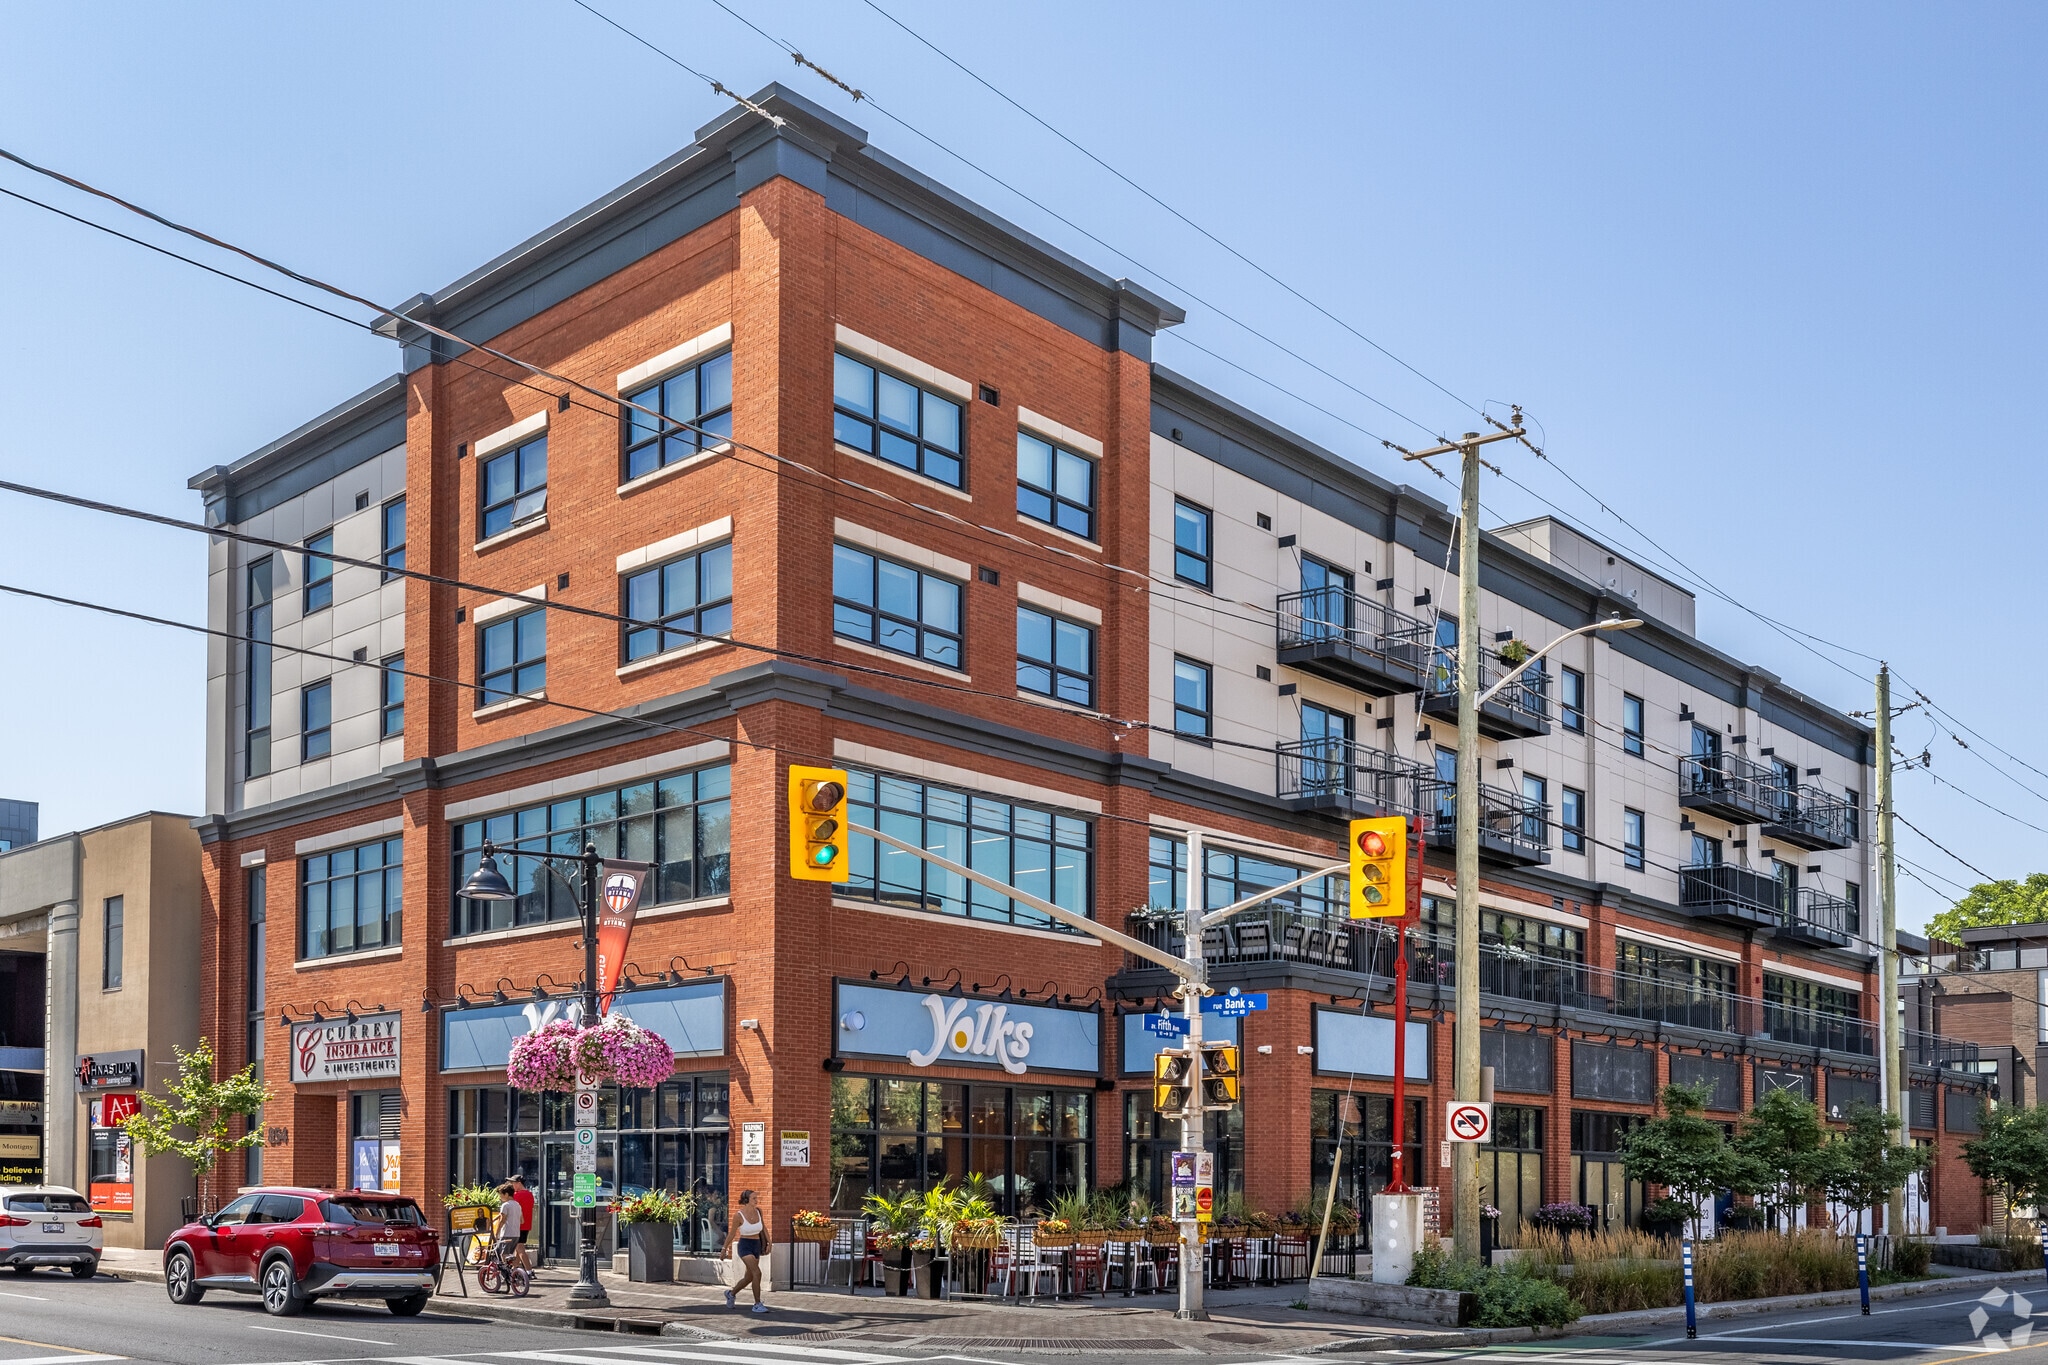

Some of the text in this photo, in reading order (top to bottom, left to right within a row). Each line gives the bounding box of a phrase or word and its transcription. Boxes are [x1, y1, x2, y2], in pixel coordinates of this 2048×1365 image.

[1225, 998, 1246, 1009] Bank
[1157, 1019, 1172, 1031] Fifth
[326, 1021, 394, 1041] CURREY
[906, 993, 1034, 1075] Yolks
[326, 1040, 394, 1058] INSURANCE
[324, 1060, 396, 1074] & INVESTMENTS
[20, 1102, 40, 1112] MAGA
[109, 1097, 134, 1125] A+
[2, 1142, 34, 1151] Montigny
[3, 1166, 43, 1174] believe in
[391, 1171, 398, 1180] IS
[0, 1174, 22, 1183] lding
[383, 1180, 400, 1190] HIRIN
